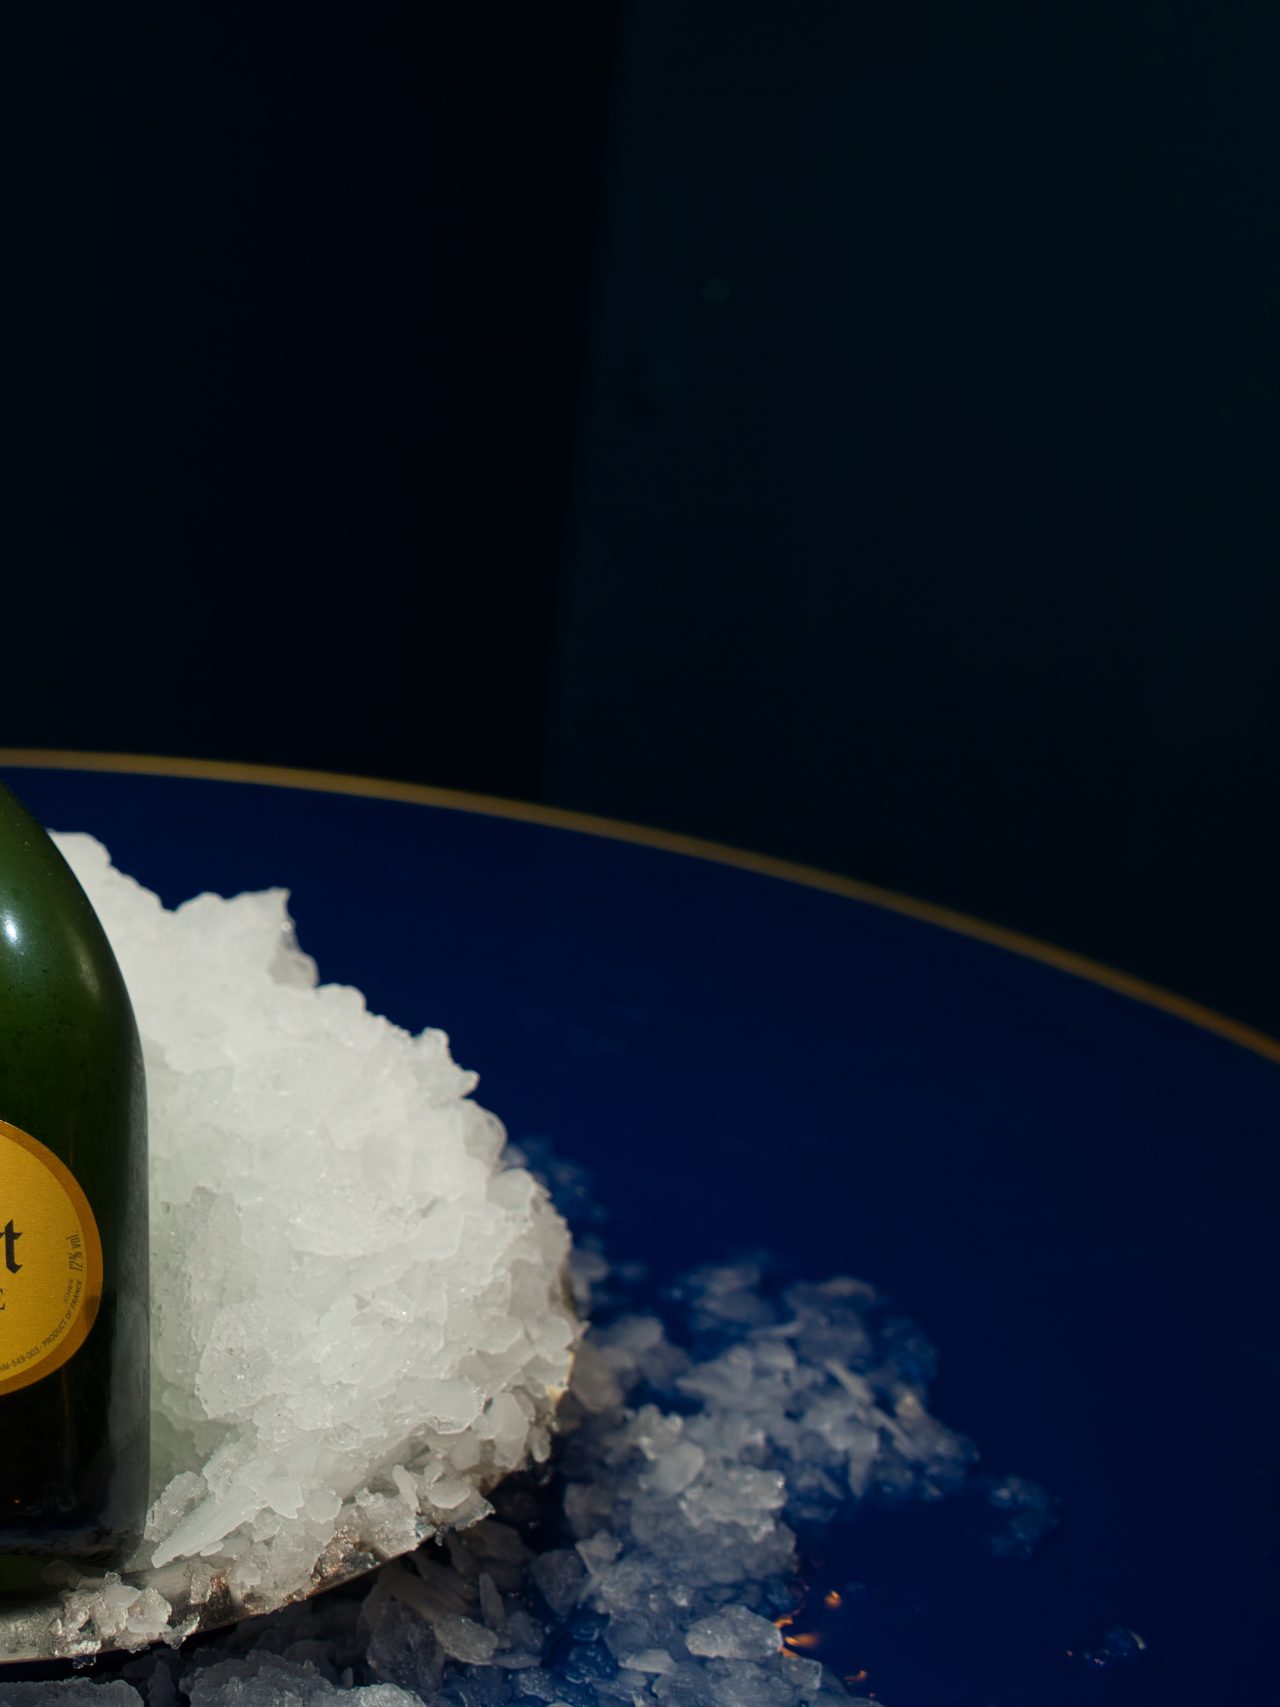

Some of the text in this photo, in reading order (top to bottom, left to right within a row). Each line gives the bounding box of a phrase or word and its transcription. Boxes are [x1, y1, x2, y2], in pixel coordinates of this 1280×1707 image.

[66, 1233, 81, 1249] vol
[42, 1318, 66, 1349] PRODUCT
[70, 1280, 82, 1310] FRANCE
